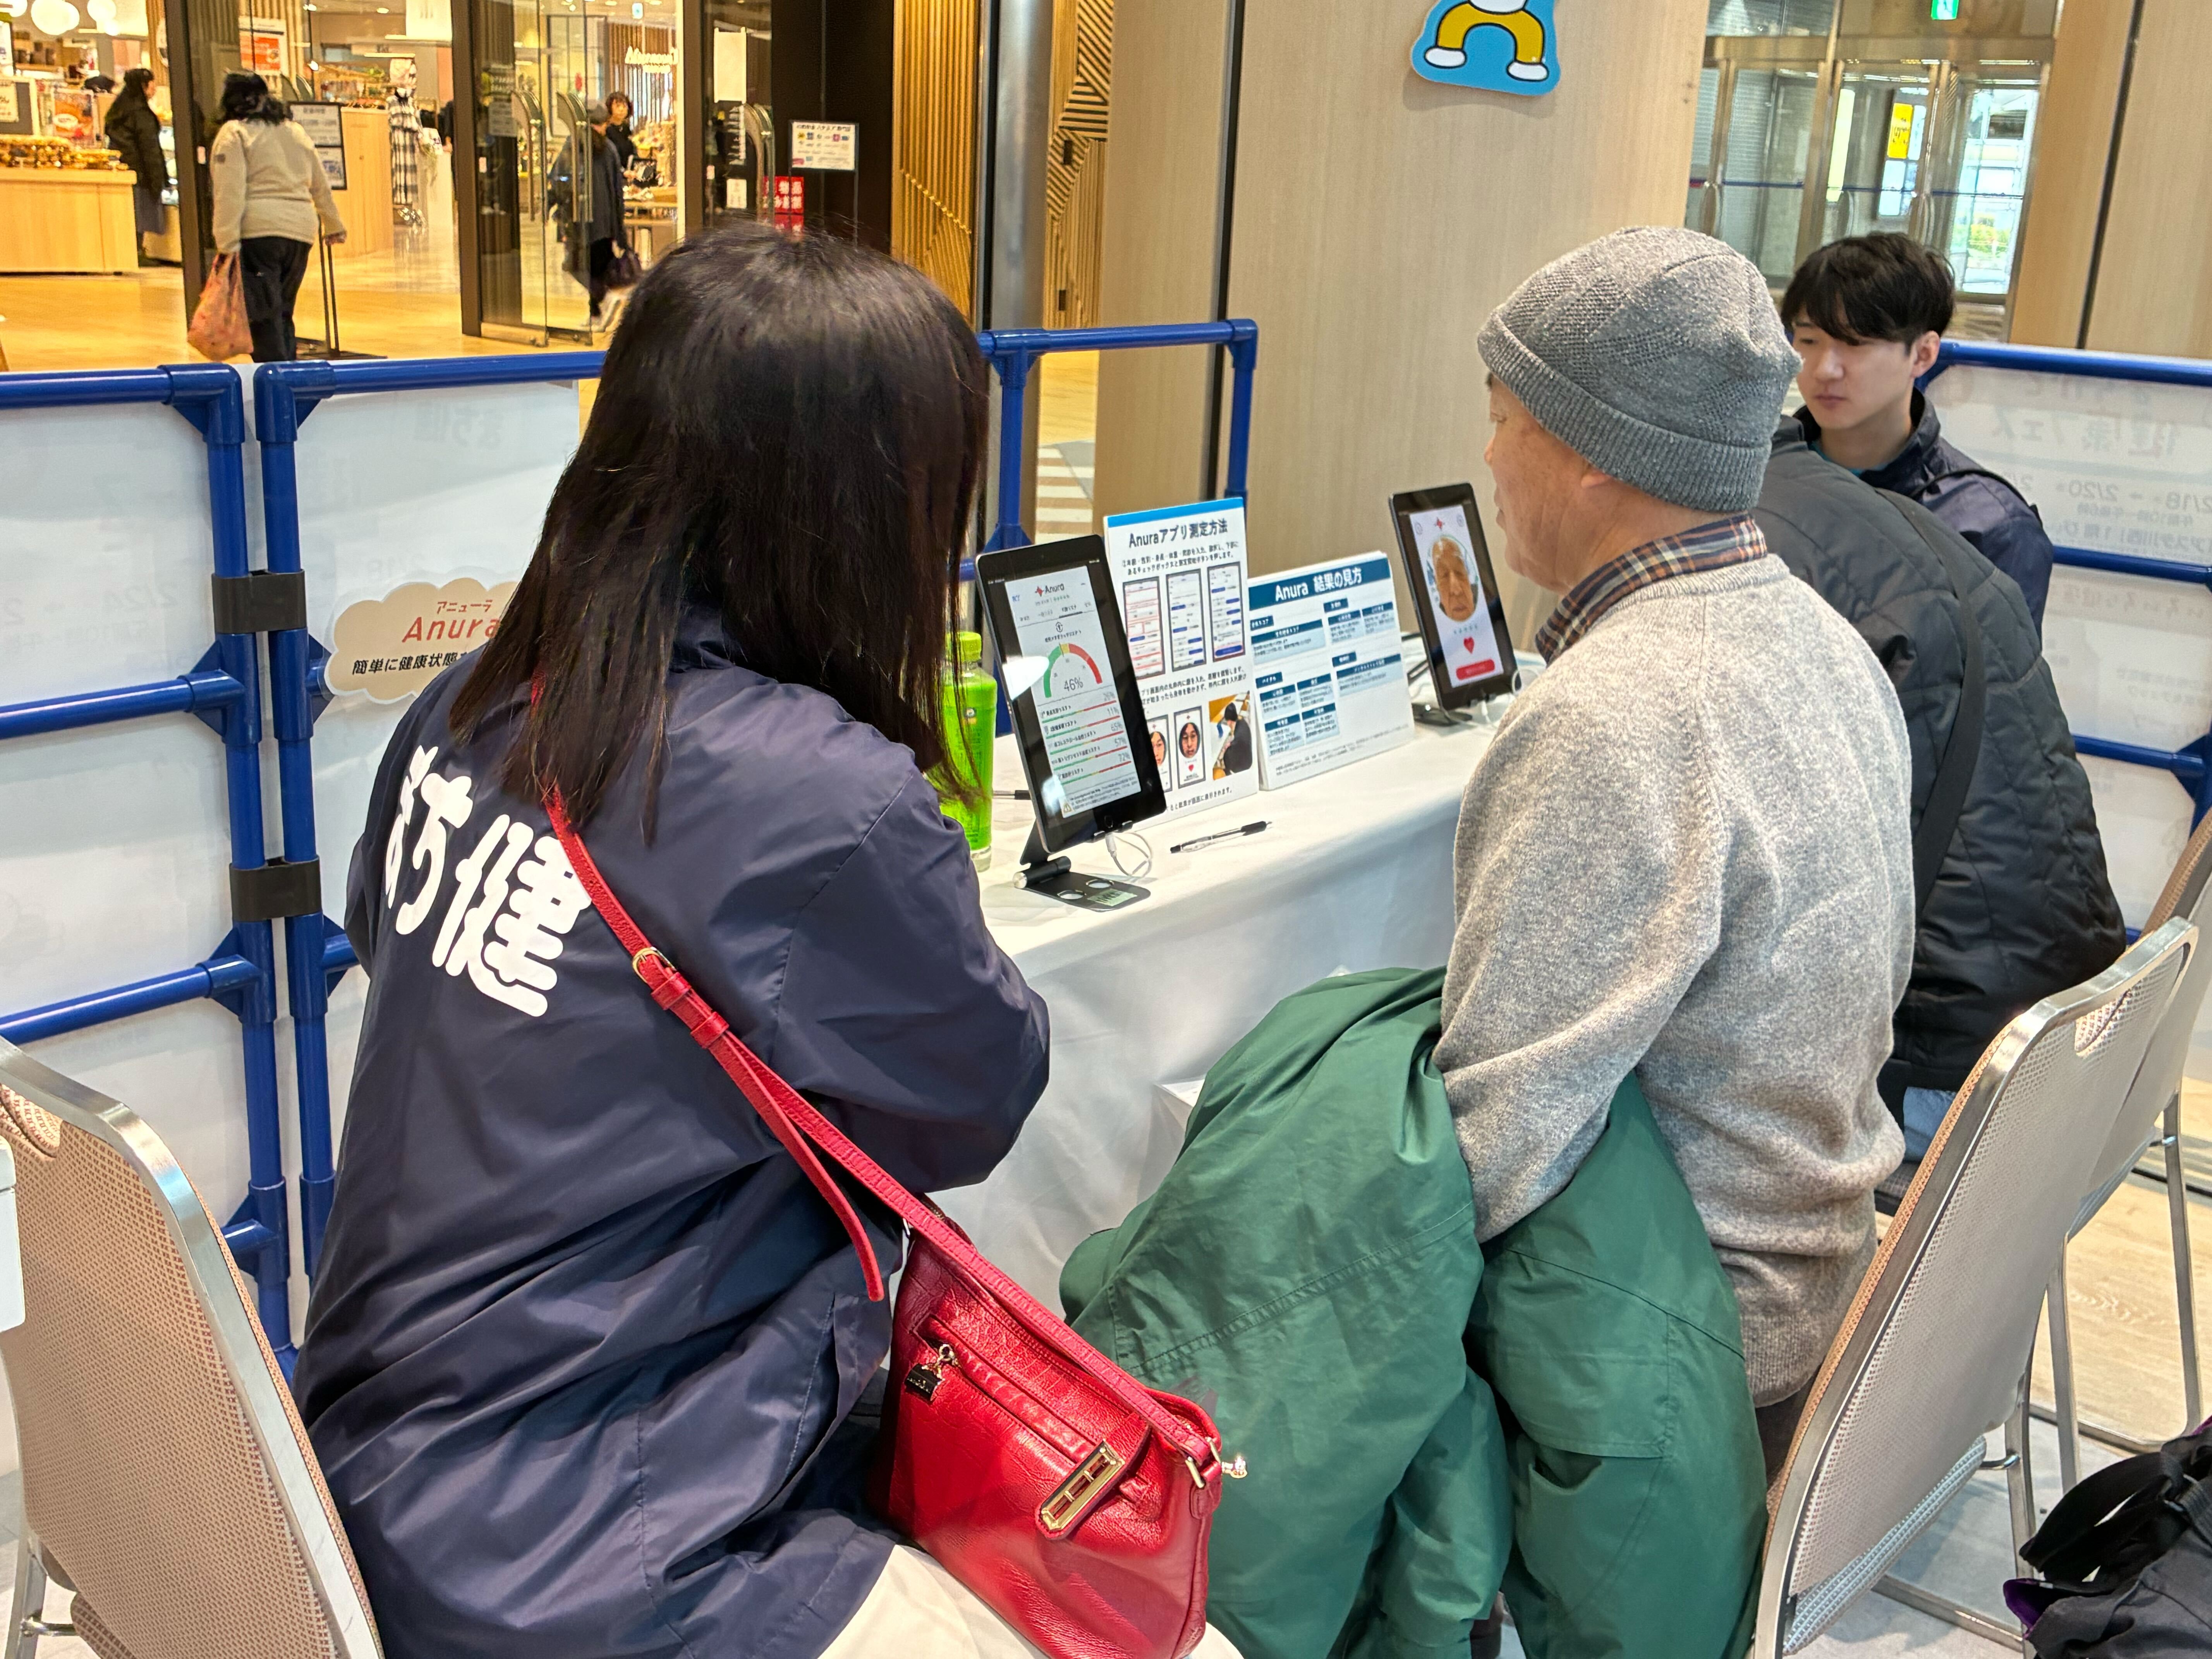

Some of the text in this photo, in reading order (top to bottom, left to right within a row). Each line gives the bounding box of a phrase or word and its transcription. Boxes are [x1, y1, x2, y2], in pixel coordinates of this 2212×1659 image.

[1128, 517, 1228, 548] Anuraアプリ測定方法
[1045, 583, 1065, 594] Anura
[1275, 567, 1362, 602] Anura 結果の見方
[436, 599, 493, 615] アニューラ
[402, 617, 502, 643] Anura
[352, 651, 468, 675] 簡単に健康状態
[1063, 677, 1084, 692] 46%
